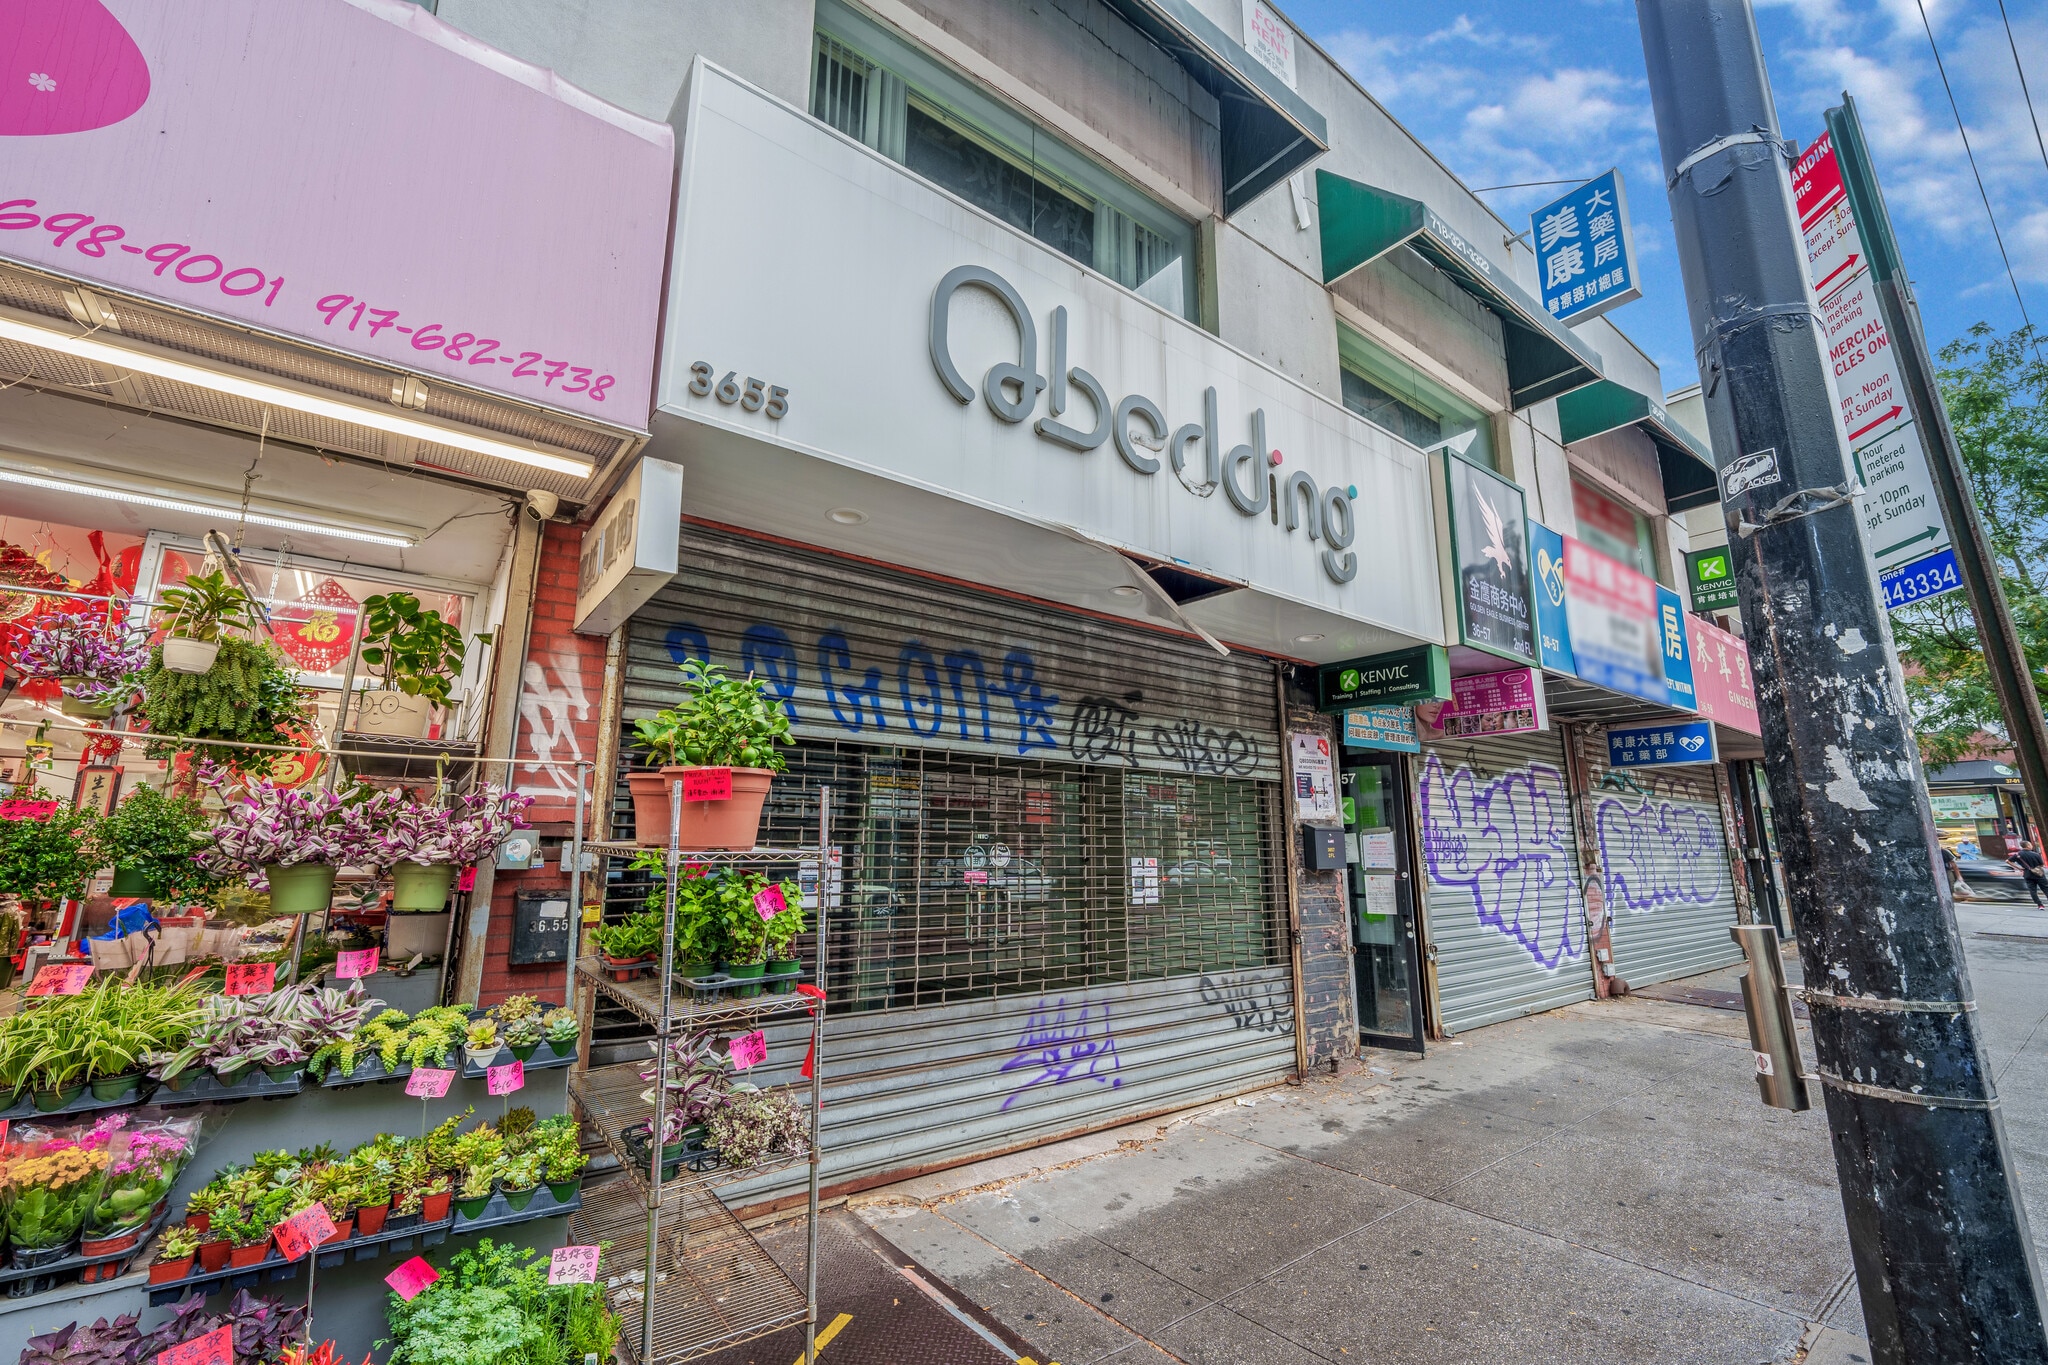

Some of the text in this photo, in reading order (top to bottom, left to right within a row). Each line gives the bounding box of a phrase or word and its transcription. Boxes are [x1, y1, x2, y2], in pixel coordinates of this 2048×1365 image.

[1255, 8, 1285, 42] FOR
[1251, 19, 1290, 60] RENT
[1585, 189, 1619, 268] 大藥房
[1539, 205, 1586, 290] 美康
[1807, 237, 1836, 263] Except
[1547, 266, 1625, 315] 醫療器材總匯
[1823, 292, 1843, 313] hour
[1826, 290, 1864, 324] metered
[1830, 306, 1863, 336] parking
[316, 293, 616, 402] 917-682-2738
[1829, 318, 1884, 363] MERCIAL
[687, 360, 790, 420] 3655
[1861, 373, 1890, 397] Noon
[1855, 386, 1893, 417] Sunday
[1863, 442, 1884, 461] hour
[1866, 443, 1906, 472] metered
[1869, 459, 1905, 486] parking
[1879, 484, 1910, 505] 10pm
[1884, 493, 1925, 521] Sunday
[1696, 579, 1733, 592] KENVIC
[1880, 567, 1906, 583] one#
[1469, 576, 1528, 619] 金鹰商务中心
[1469, 602, 1486, 614] GOLDEN
[1486, 608, 1499, 620] EAGLE
[1498, 612, 1516, 626] BUSINESS
[1471, 622, 1491, 641] 36-57
[1662, 604, 1682, 661] 房
[1513, 637, 1533, 656] 2nd FL
[1360, 665, 1409, 685] KENVIC
[1332, 682, 1420, 701] Training Staffing Consulting
[1612, 731, 1675, 749] 美康大藥房
[1622, 748, 1668, 762] 配藥部
[529, 919, 569, 933] 36.55
